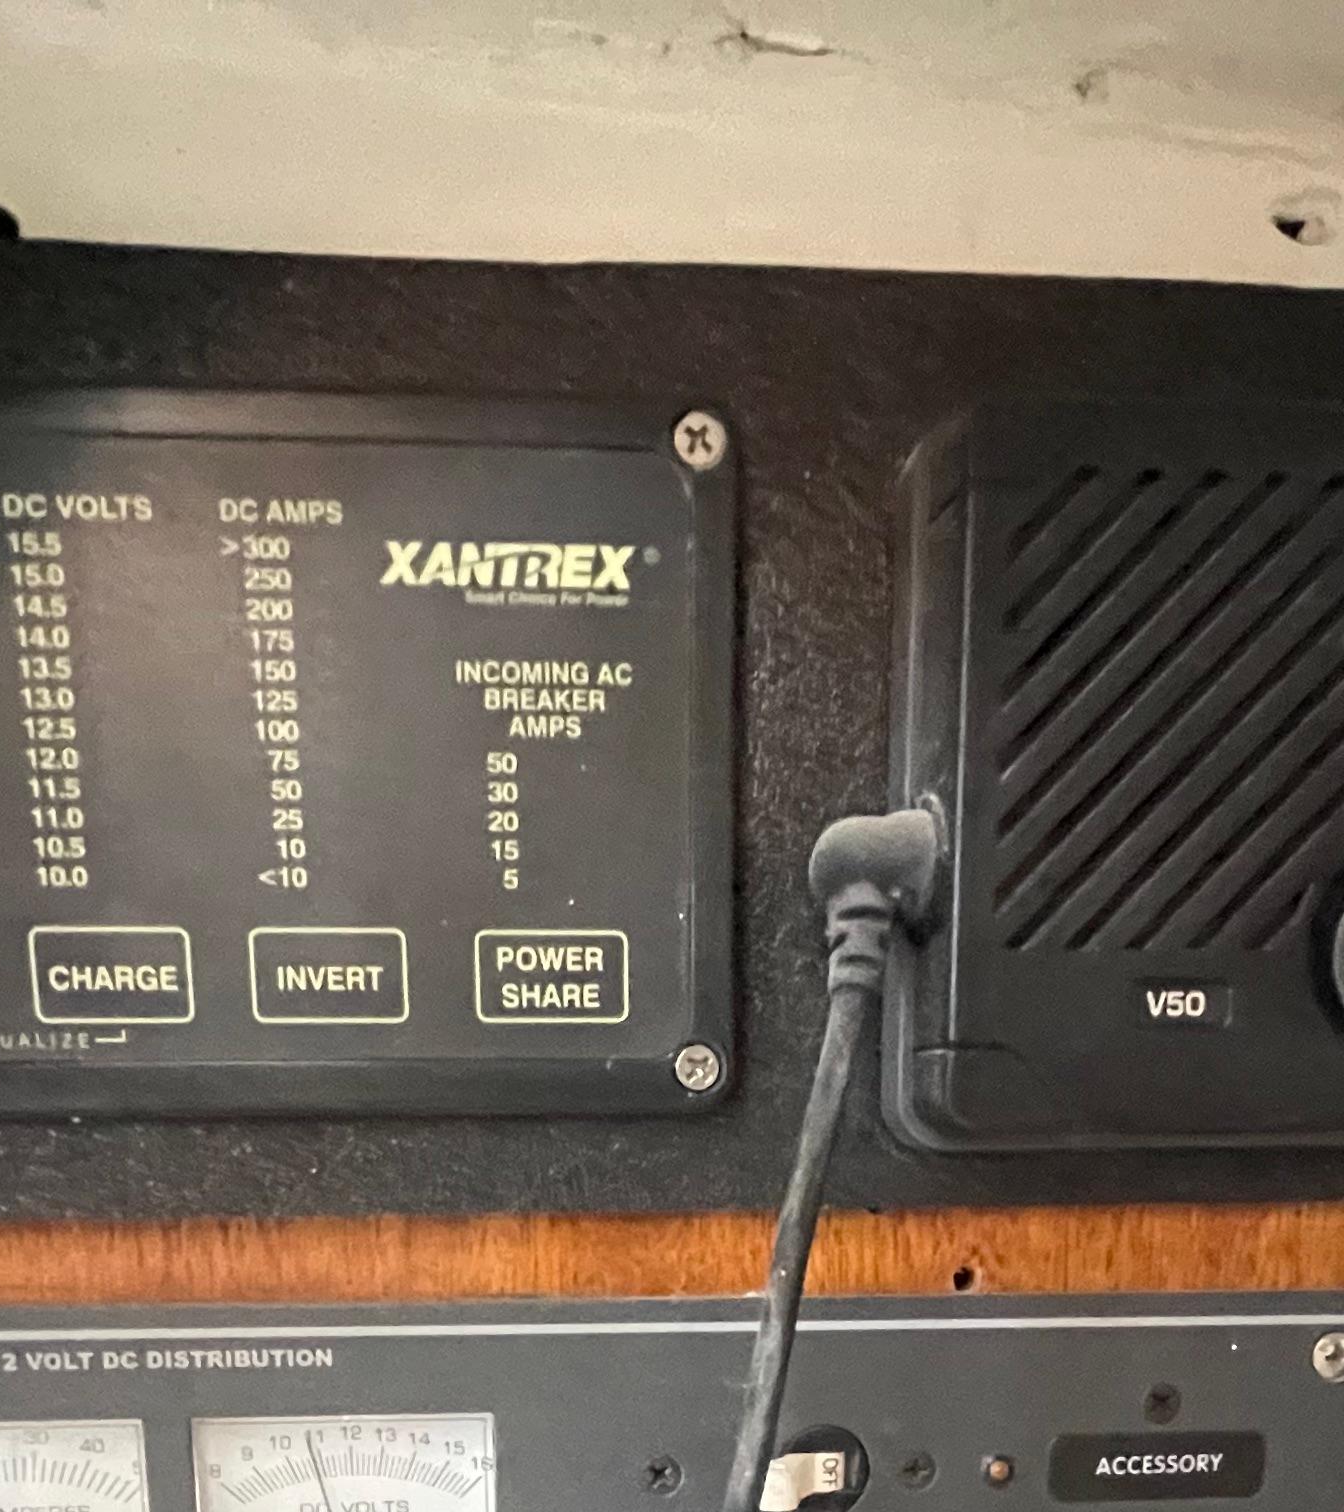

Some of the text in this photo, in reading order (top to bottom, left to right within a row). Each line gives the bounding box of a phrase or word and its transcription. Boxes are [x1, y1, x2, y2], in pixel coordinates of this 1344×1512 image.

[3, 494, 152, 521] DC VOLTS
[219, 498, 343, 524] DC AMPS
[9, 532, 63, 556] 15.5
[11, 563, 65, 587] 15.0
[380, 541, 634, 589] XANTREX
[245, 567, 292, 590] 250
[14, 595, 67, 618] 14.5
[246, 599, 293, 621] 200
[18, 626, 70, 648] 14.0
[250, 629, 294, 652] 175
[19, 657, 72, 680] 13.5
[251, 660, 296, 681] 150
[456, 660, 632, 686] INCOMING AC
[21, 687, 74, 710] 13.0
[253, 690, 297, 711] 125
[485, 688, 605, 711] BREAKER
[24, 718, 76, 739] 12.5
[256, 720, 299, 742] 100
[510, 715, 581, 738] AMPS
[27, 748, 79, 769] 12.0
[268, 750, 299, 771] 75
[487, 753, 517, 774] 50
[29, 778, 80, 799] 11.5
[271, 779, 302, 800] 50
[488, 782, 518, 802] 30
[32, 807, 84, 828] 11.0
[273, 809, 303, 830] 25
[488, 811, 518, 831] 20
[33, 837, 86, 858] 10.5
[277, 838, 306, 859] 10
[492, 840, 519, 860] 15
[37, 866, 88, 887] 10.0
[504, 869, 518, 889] 5
[497, 946, 603, 971] POWER
[49, 965, 178, 991] CHARGE
[277, 966, 383, 991] INVERT
[502, 983, 600, 1008] SHARE
[1147, 991, 1205, 1017] V50
[26, 1352, 93, 1370] VOLT
[103, 1351, 138, 1369] DC
[147, 1349, 332, 1368] DISTRIBUTION
[23, 1430, 49, 1445] 30
[270, 1435, 291, 1450] 10
[340, 1425, 362, 1440] 12
[376, 1428, 397, 1442] 13
[409, 1432, 430, 1446] 14
[79, 1438, 105, 1453] 40
[242, 1447, 253, 1461] 9
[445, 1440, 465, 1455] 15
[209, 1464, 221, 1478] 8
[821, 1456, 839, 1491] OFF
[1096, 1454, 1223, 1475] ACCESSORY
